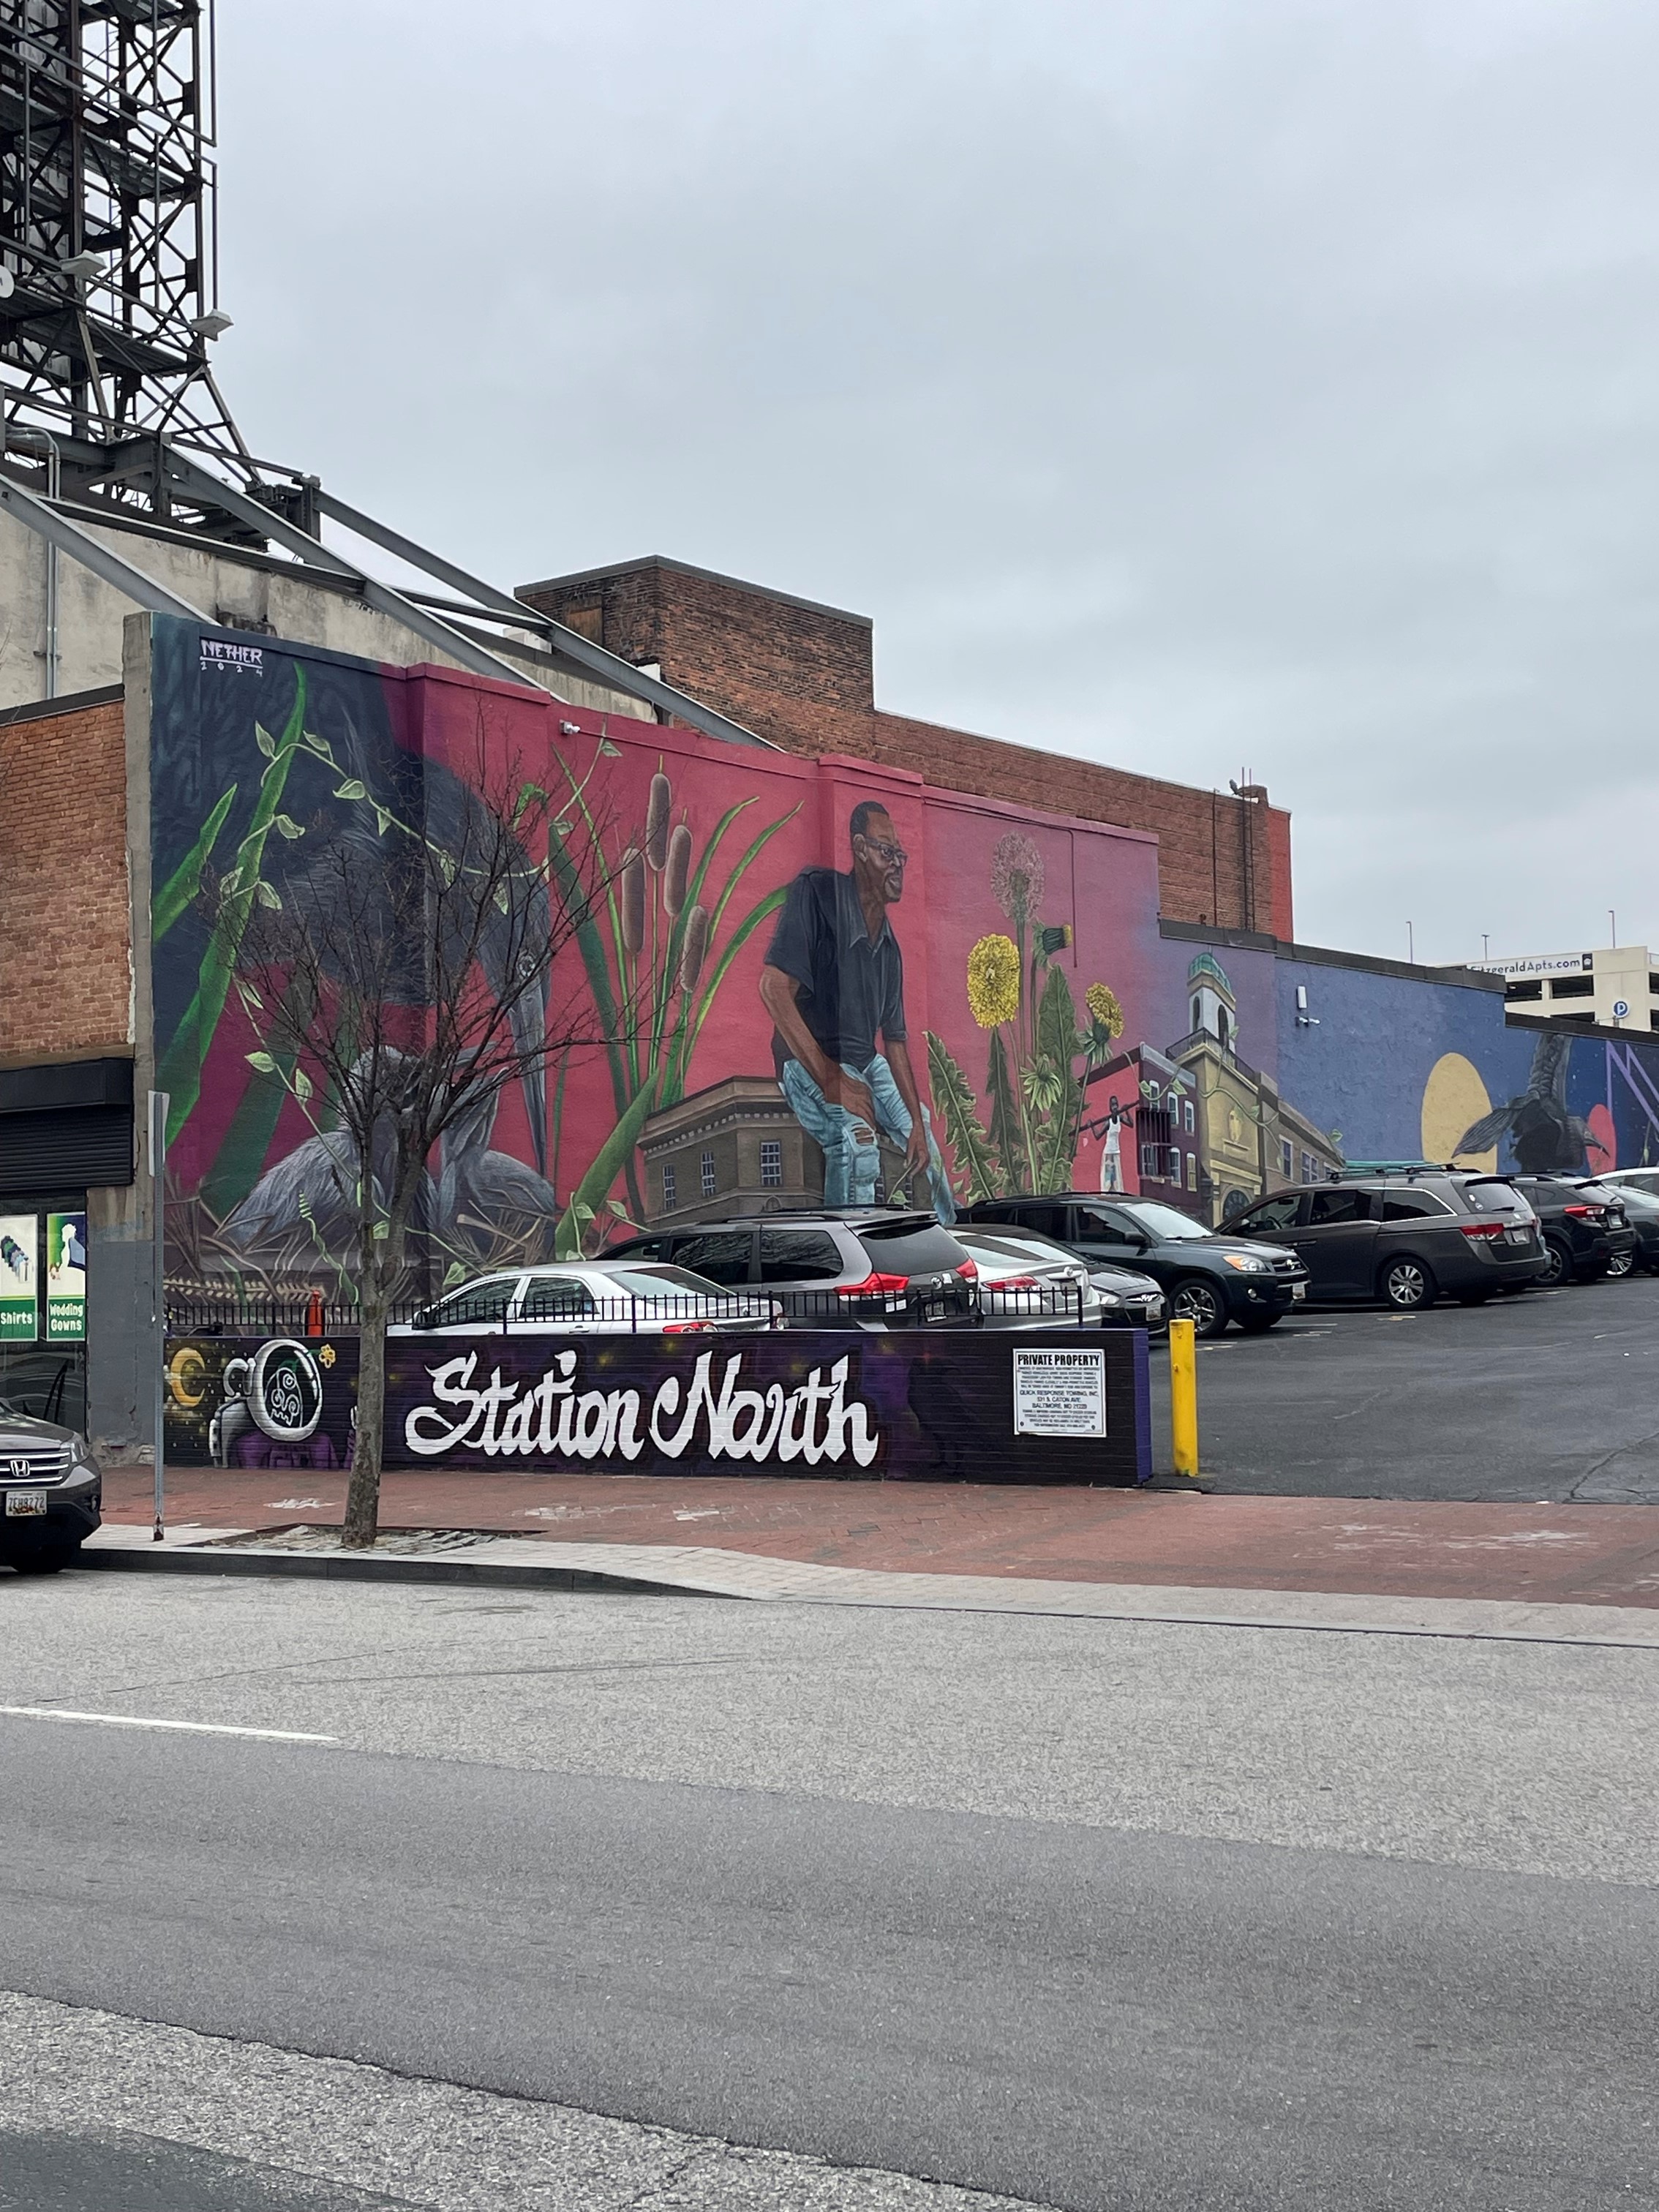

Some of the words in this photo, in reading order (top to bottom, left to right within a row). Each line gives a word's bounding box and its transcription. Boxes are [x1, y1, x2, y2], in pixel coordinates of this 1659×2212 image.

[200, 639, 263, 665] NETHER
[1470, 959, 1581, 974] tzgeraldApts.com
[50, 1303, 83, 1317] Wedding
[1, 1312, 33, 1325] Shirts
[50, 1319, 82, 1331] Gowns
[1017, 1354, 1053, 1366] PRIVATE
[1054, 1355, 1099, 1366] PROPERTY
[405, 1350, 645, 1461] Station
[649, 1350, 879, 1467] North
